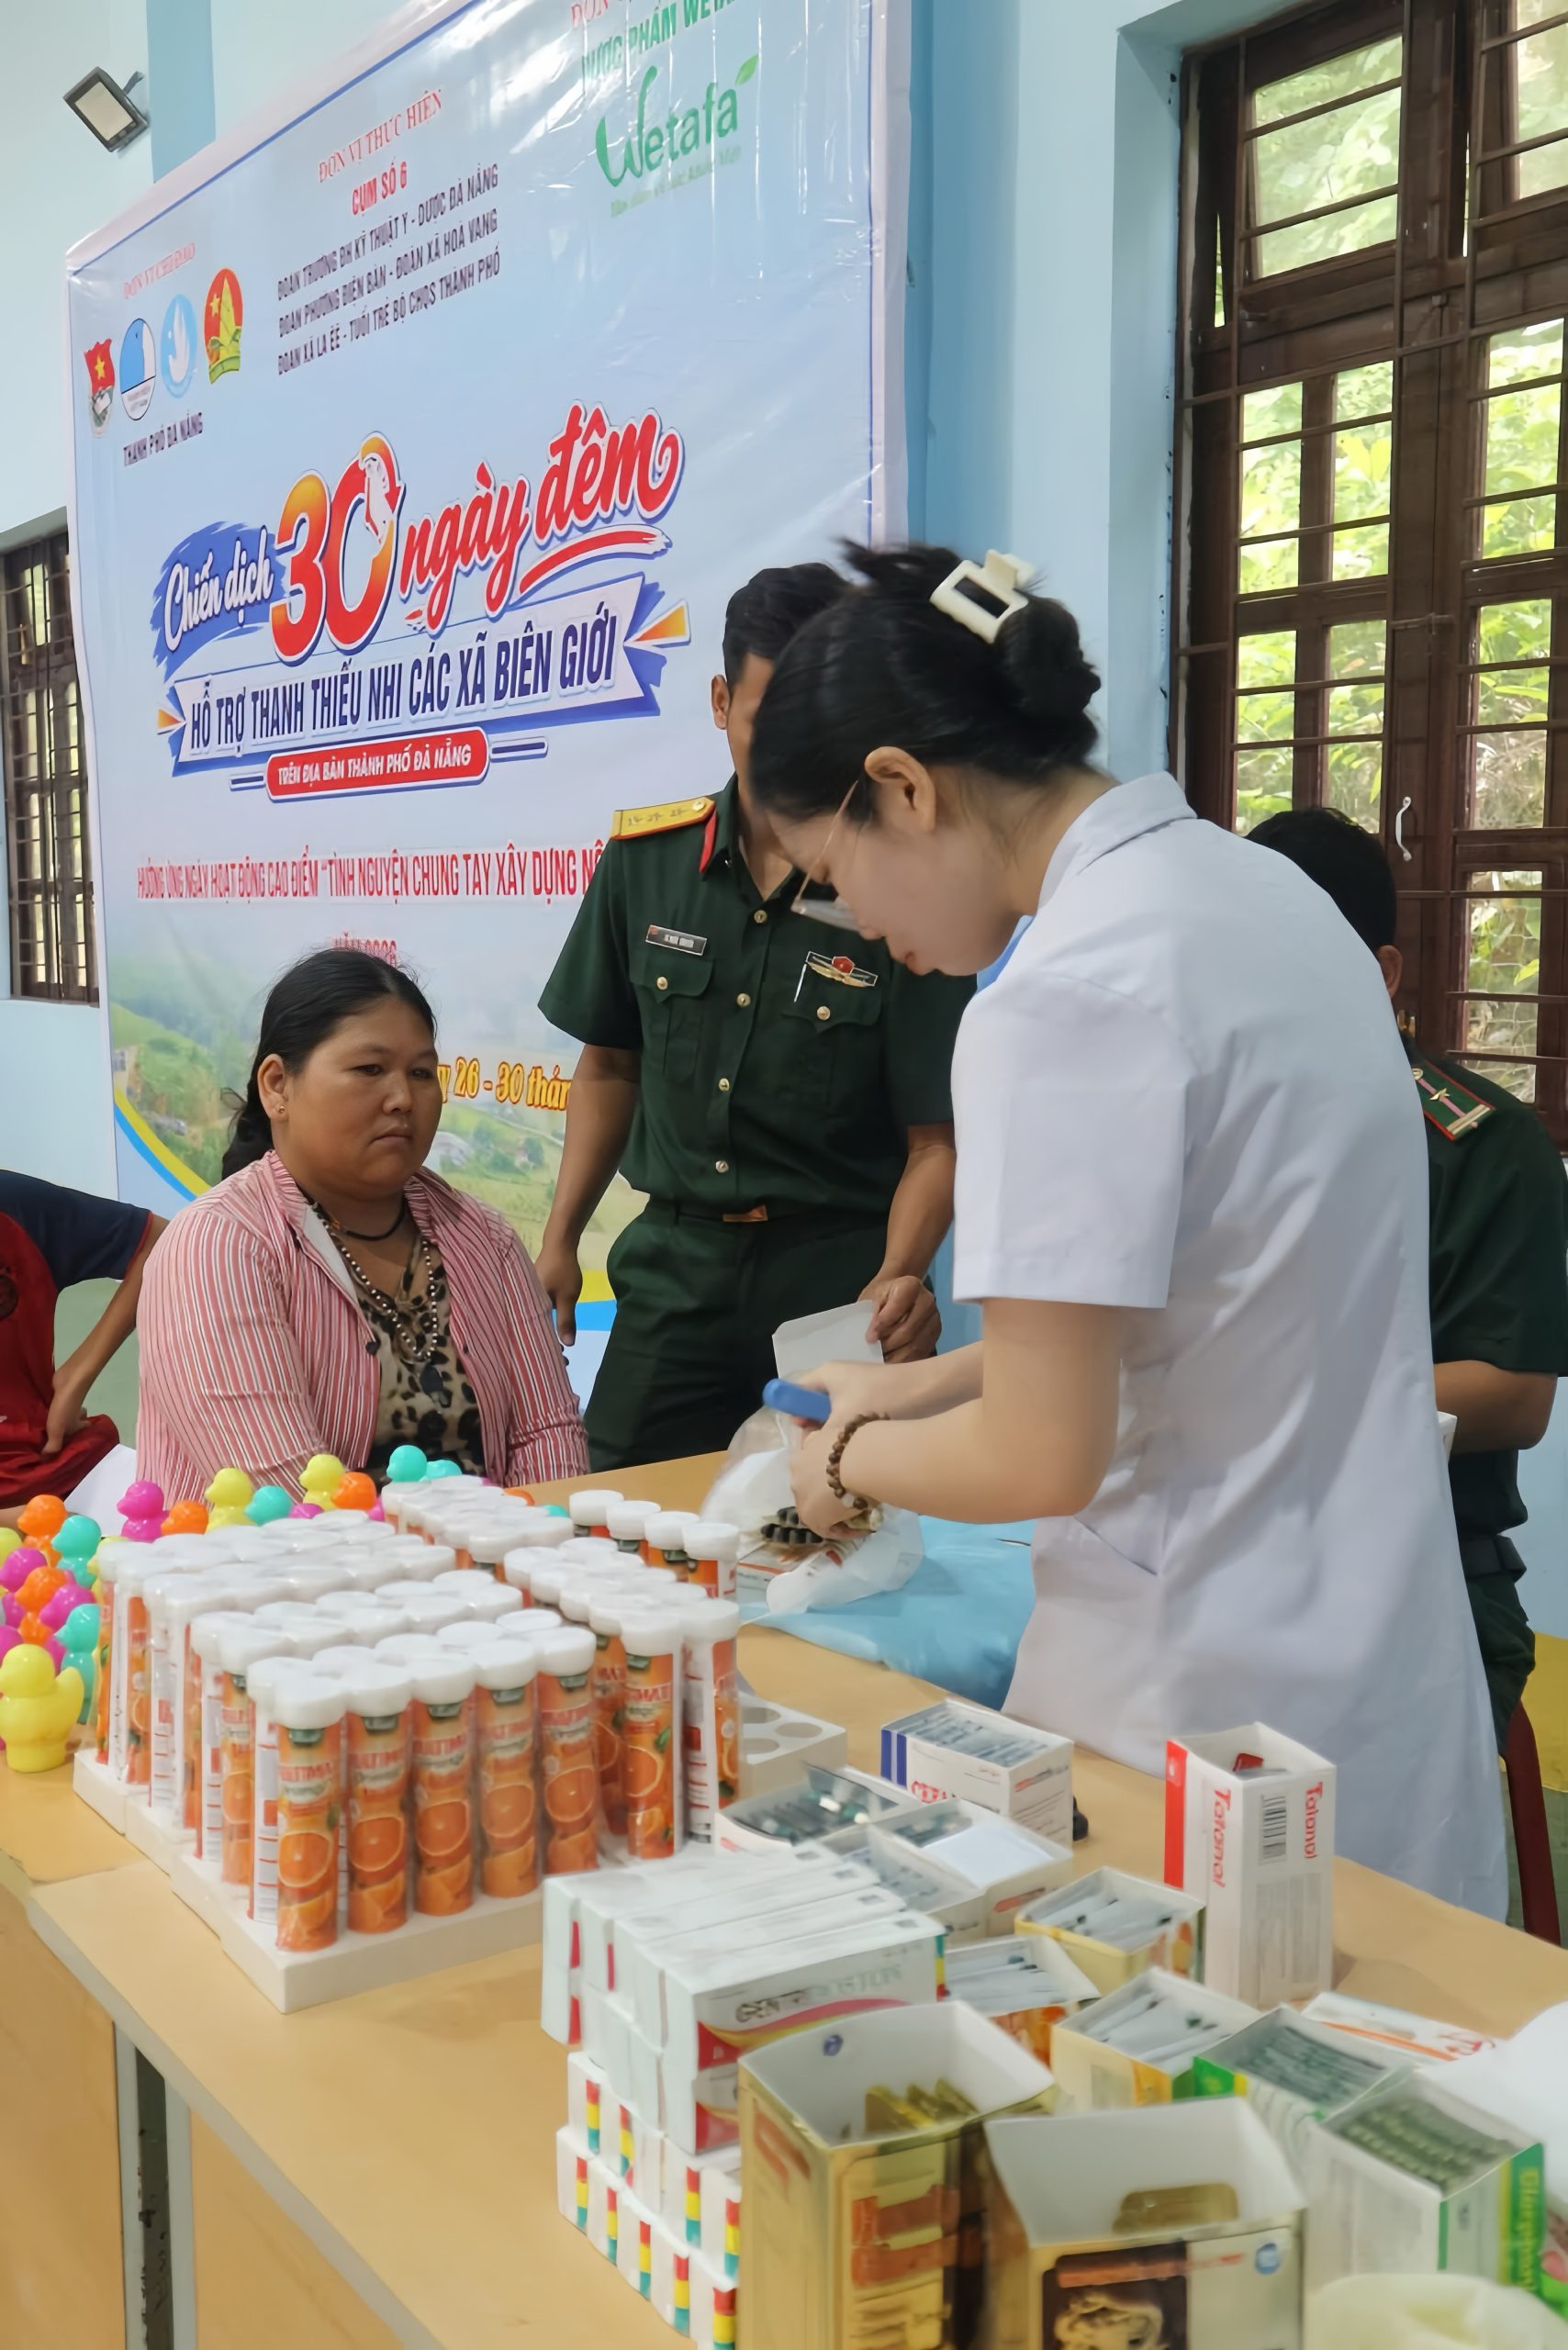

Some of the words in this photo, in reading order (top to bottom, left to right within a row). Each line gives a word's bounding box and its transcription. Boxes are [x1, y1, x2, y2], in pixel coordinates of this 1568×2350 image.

[596, 65, 737, 187] Wetafa
[381, 157, 397, 199] SỐ
[400, 161, 408, 189] 6
[468, 208, 498, 243] VANG
[165, 548, 223, 653] Chiến
[224, 525, 274, 626] dịch
[271, 432, 398, 665] 30
[398, 461, 530, 635] ngày
[534, 400, 685, 545] đêm
[191, 679, 211, 749] HỖ
[217, 687, 246, 753] TRỢ
[252, 681, 305, 740] THANH
[311, 658, 362, 731] THIẾU
[368, 663, 403, 722] NHI
[409, 642, 451, 716] CÁC
[456, 631, 487, 708] XÃ
[494, 621, 553, 701] BIÊN
[559, 601, 617, 689] GIỚI
[386, 744, 412, 774] PHỐ
[413, 744, 431, 771] ĐÀ
[267, 861, 288, 898] CAO
[358, 848, 409, 904] NGUYỆN
[412, 853, 459, 897] CHUNG
[462, 853, 491, 897] TAY
[496, 843, 528, 897] XÂY
[532, 847, 577, 905] DỰNG
[454, 1057, 480, 1099] 26
[496, 1061, 524, 1104] 30
